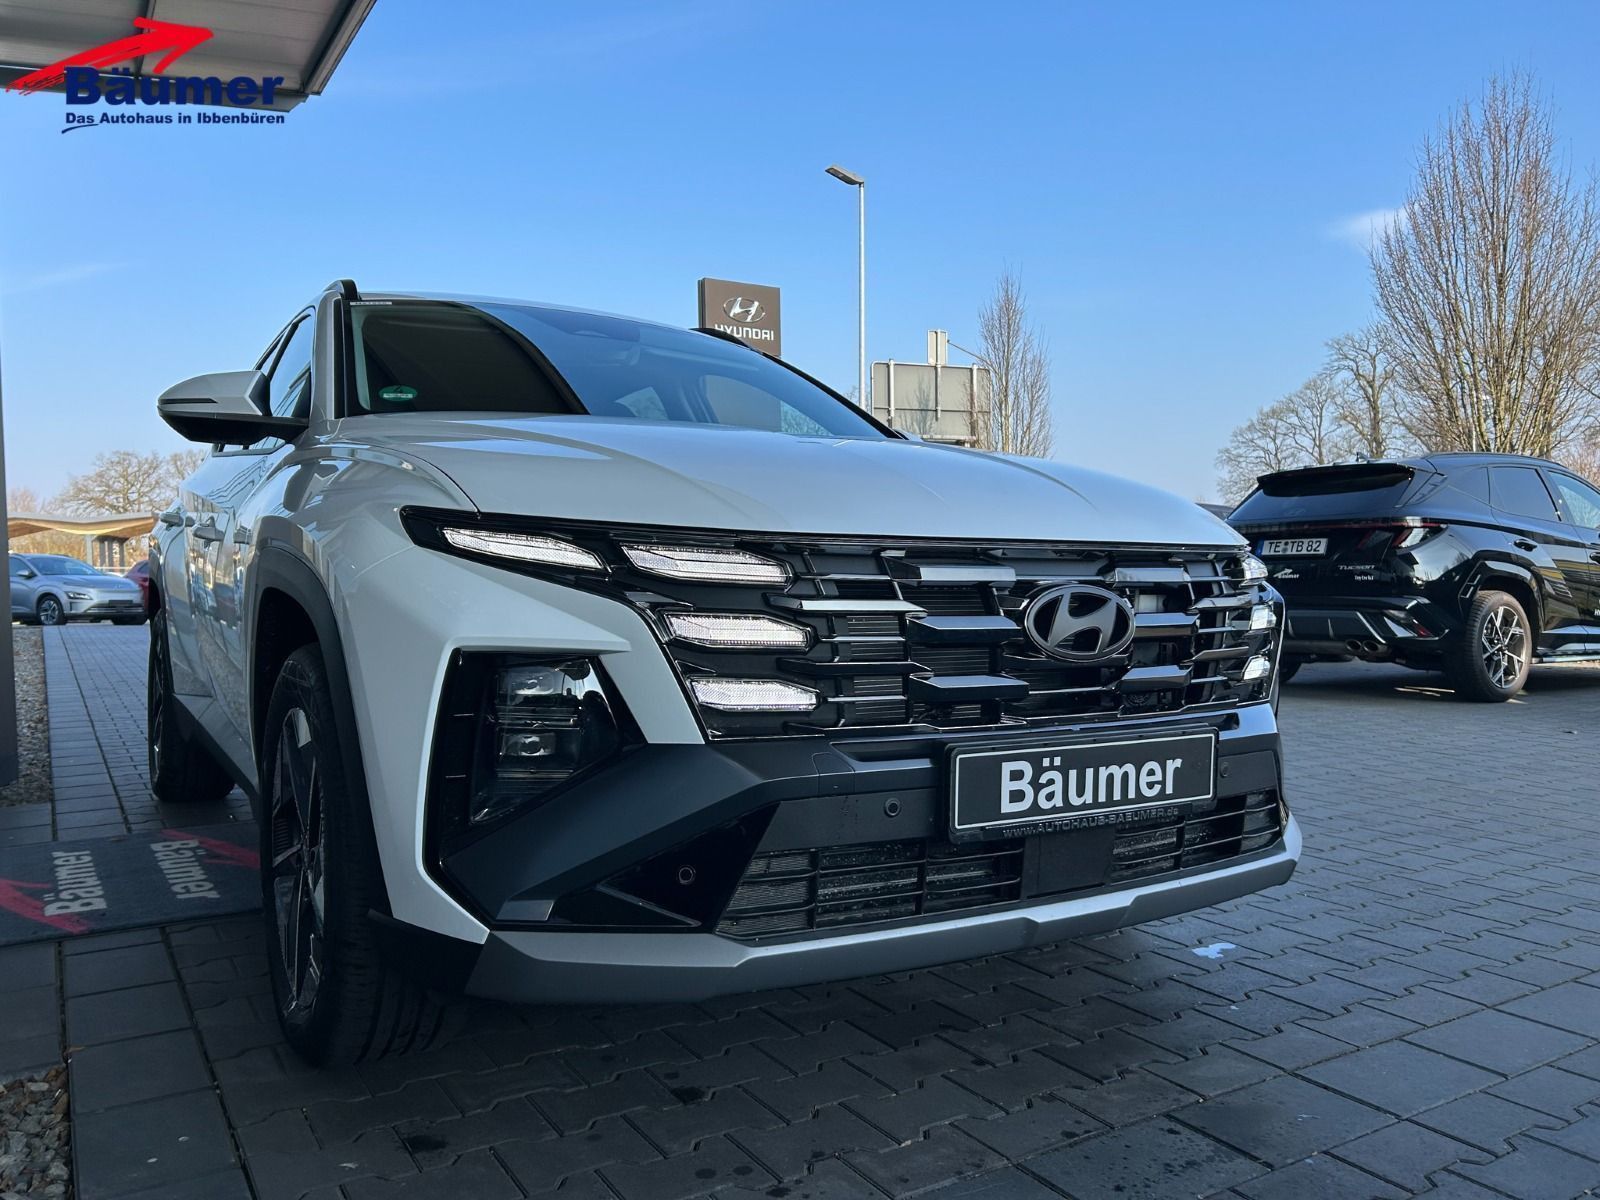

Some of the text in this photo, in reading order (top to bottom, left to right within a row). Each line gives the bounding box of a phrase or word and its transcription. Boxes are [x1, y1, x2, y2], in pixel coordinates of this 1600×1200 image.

[714, 324, 774, 340] HYUNDAI
[1268, 540, 1322, 553] TE TB 82
[1001, 757, 1182, 813] Bäumer
[43, 850, 107, 916] Bäumer
[150, 839, 220, 899] Bäumer
